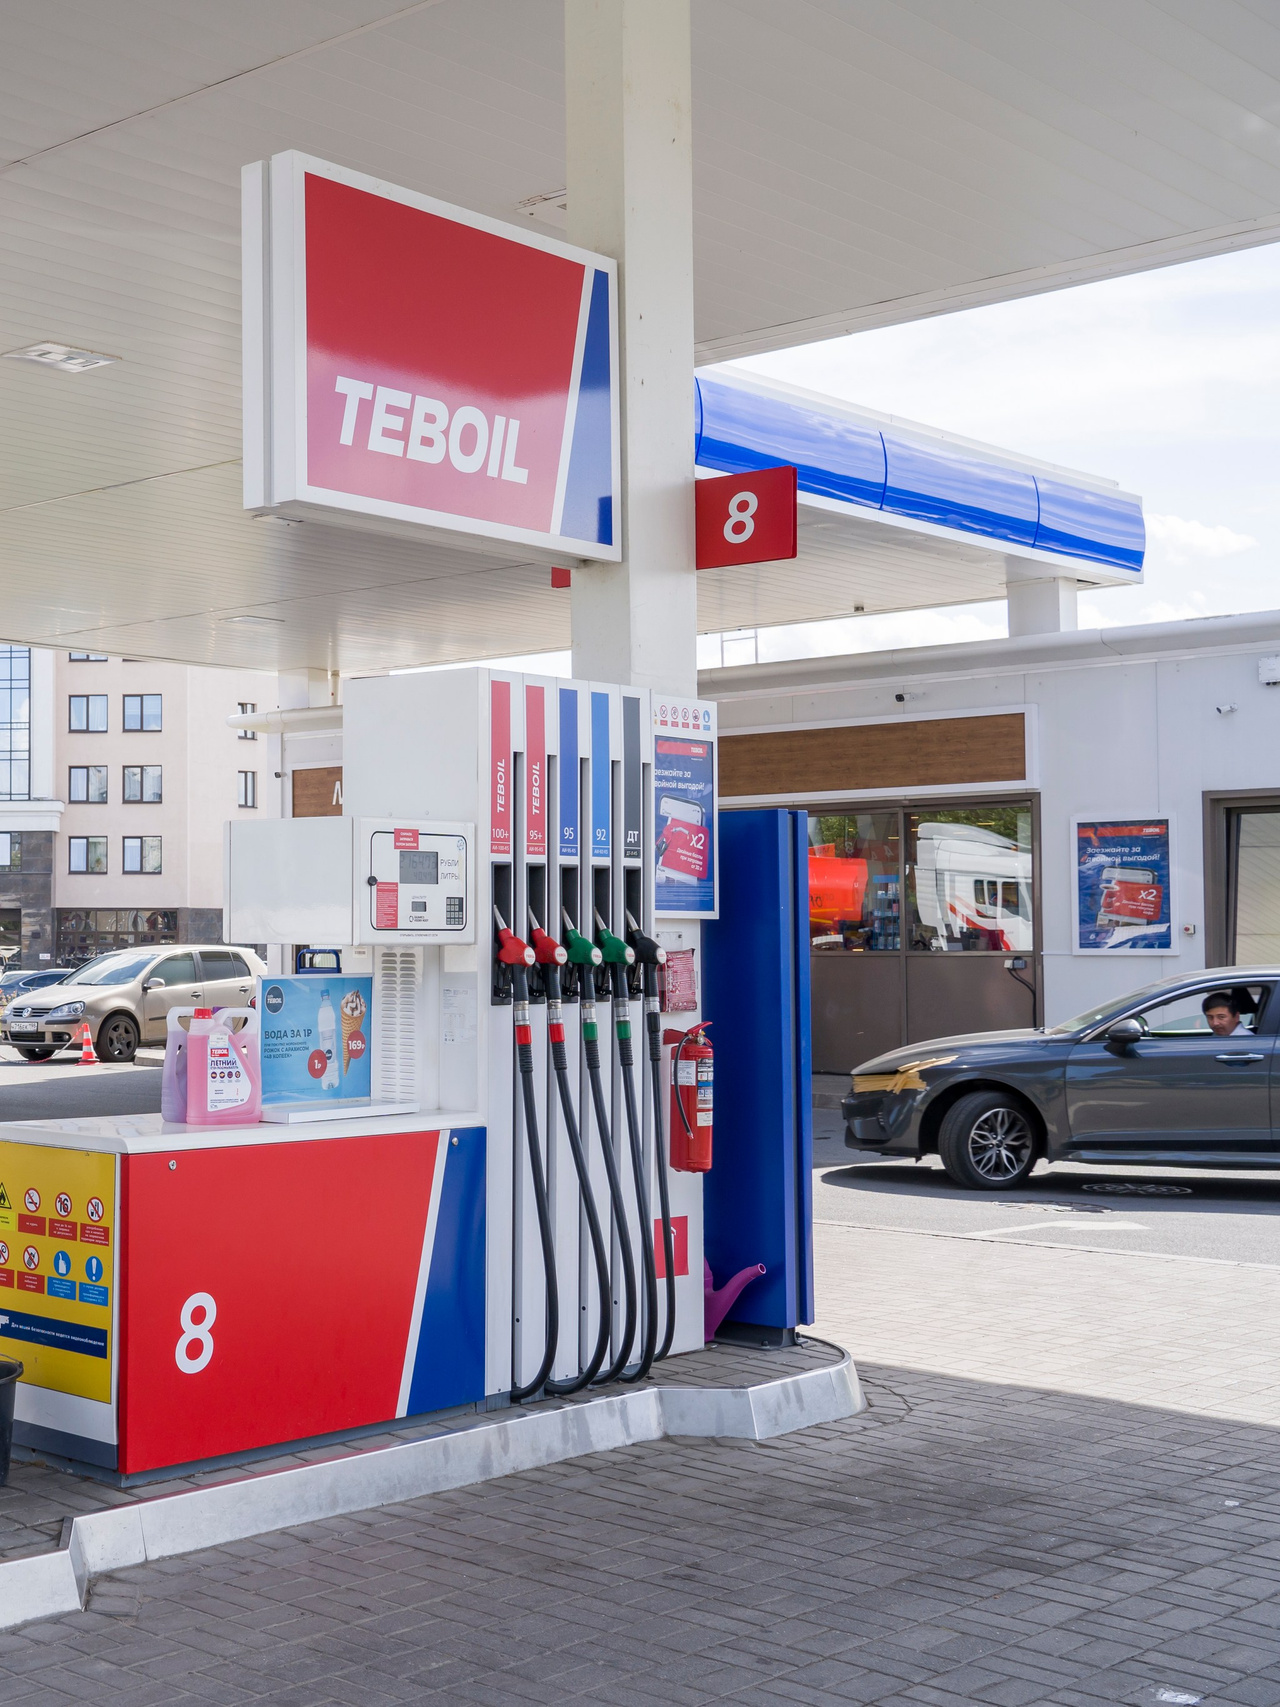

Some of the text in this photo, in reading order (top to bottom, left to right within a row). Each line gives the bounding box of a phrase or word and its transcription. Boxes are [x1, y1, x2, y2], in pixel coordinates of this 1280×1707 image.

[335, 376, 528, 484] TEBOIL
[723, 491, 758, 543] 8
[655, 768, 683, 777] аезжайте
[497, 759, 505, 813] TEBOIL
[532, 762, 540, 815] TEBOIL
[655, 780, 704, 790] войной выгодой!
[492, 828, 509, 839] 100+
[529, 830, 542, 840] 95+
[564, 827, 574, 840] 95
[596, 828, 606, 840] 92
[627, 831, 638, 843] ДТ
[1086, 846, 1130, 854] Заезжайте
[440, 859, 459, 867] РУБЛИ
[1123, 854, 1160, 862] выгодой!
[264, 1030, 288, 1040] ВОДА
[291, 1029, 301, 1038] ЗА
[211, 1058, 237, 1066] ЛЕТНИЙ
[175, 1292, 217, 1374] 8
